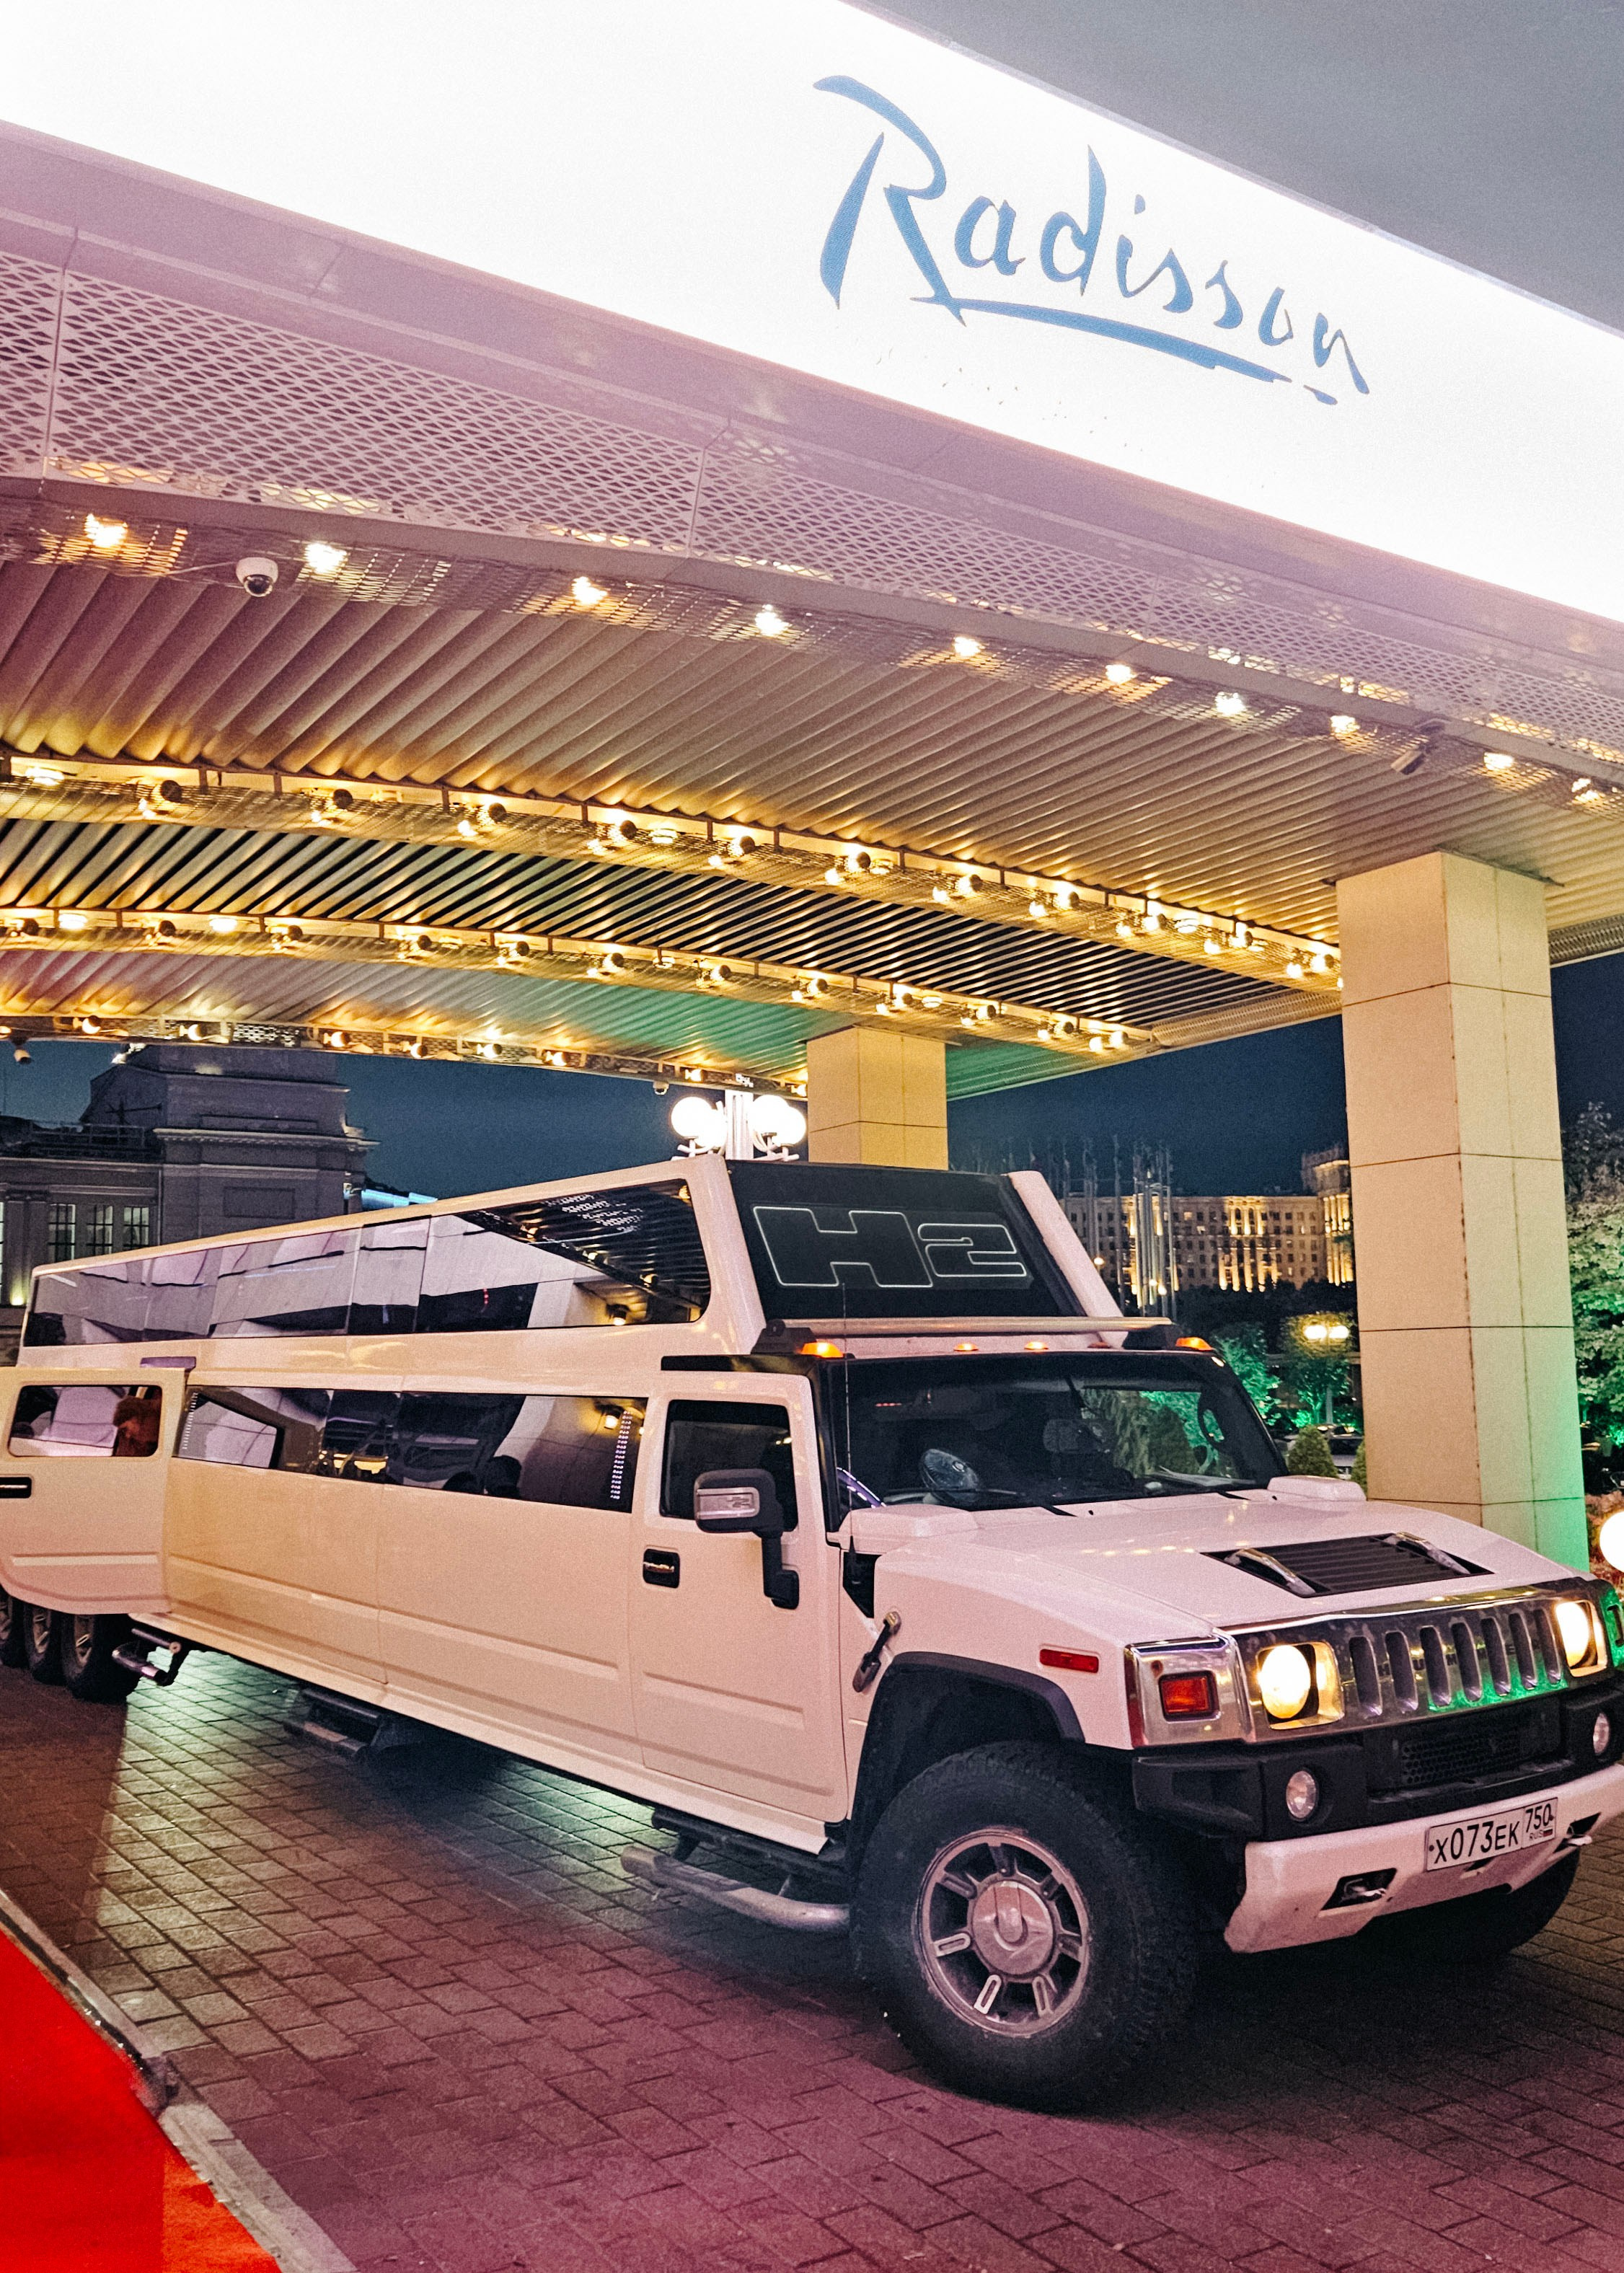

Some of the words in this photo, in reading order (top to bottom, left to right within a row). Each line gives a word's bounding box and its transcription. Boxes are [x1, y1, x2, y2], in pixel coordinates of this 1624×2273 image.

[813, 74, 1370, 403] Radisson
[753, 1206, 1028, 1288] H2
[1525, 1803, 1552, 1833] 750
[1529, 1829, 1543, 1840] RUS
